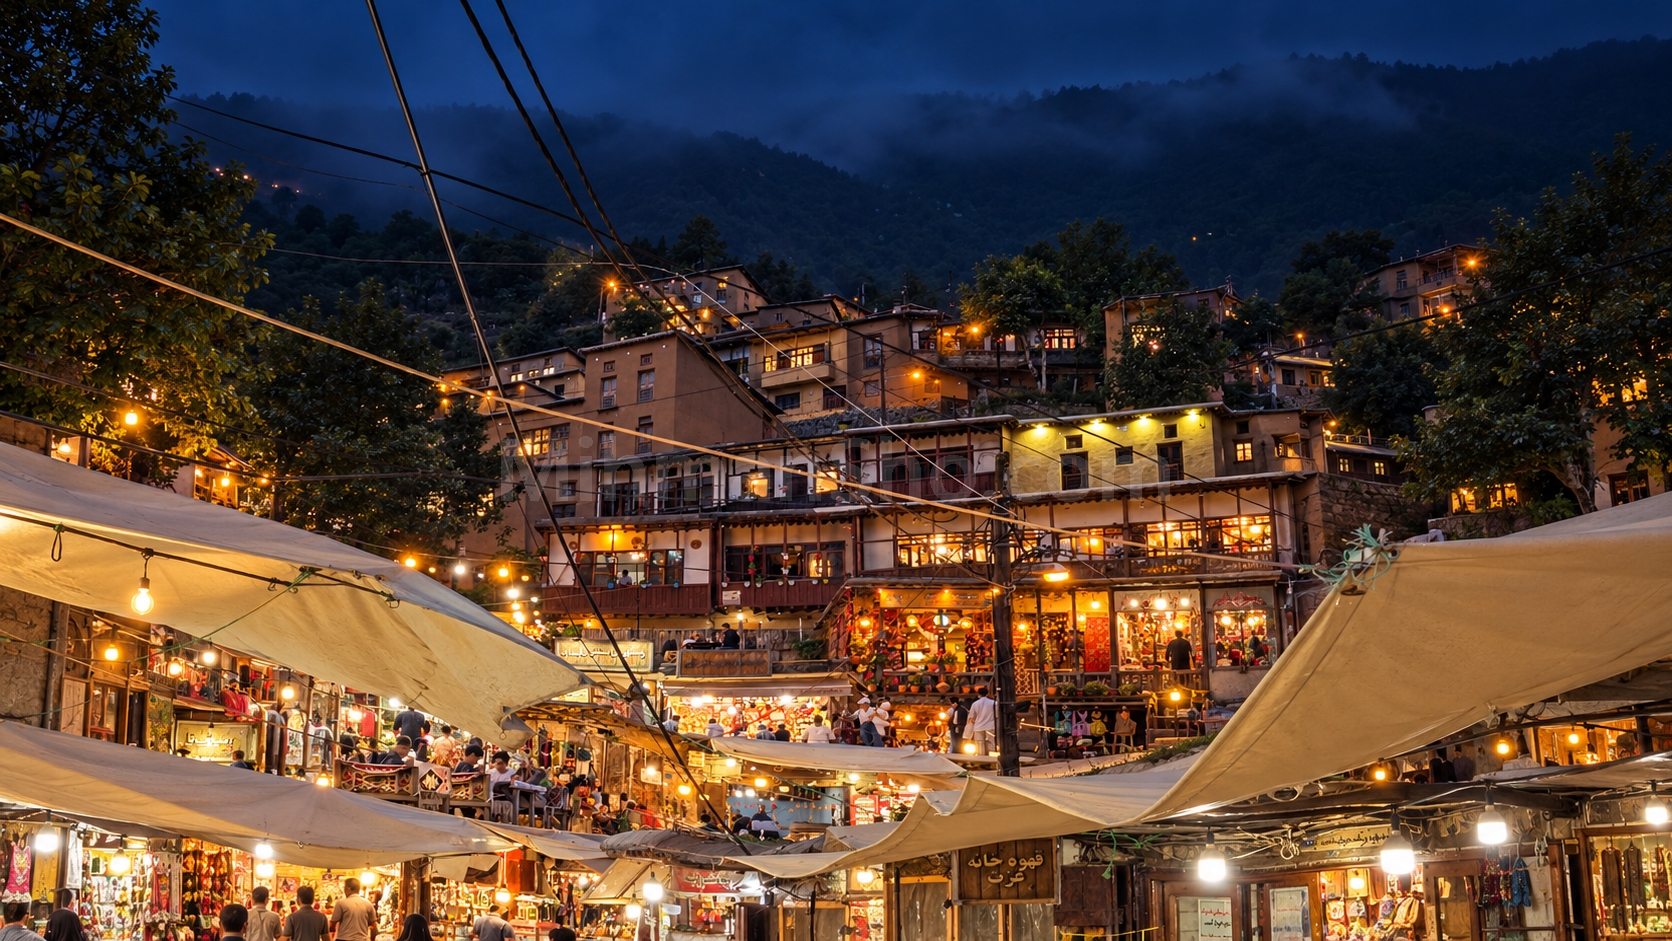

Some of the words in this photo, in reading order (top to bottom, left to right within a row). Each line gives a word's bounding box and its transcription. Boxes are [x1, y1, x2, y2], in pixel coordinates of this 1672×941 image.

[967, 853, 1003, 868] خانه
[1008, 850, 1044, 871] قهوه
[987, 870, 1025, 887] عزت
